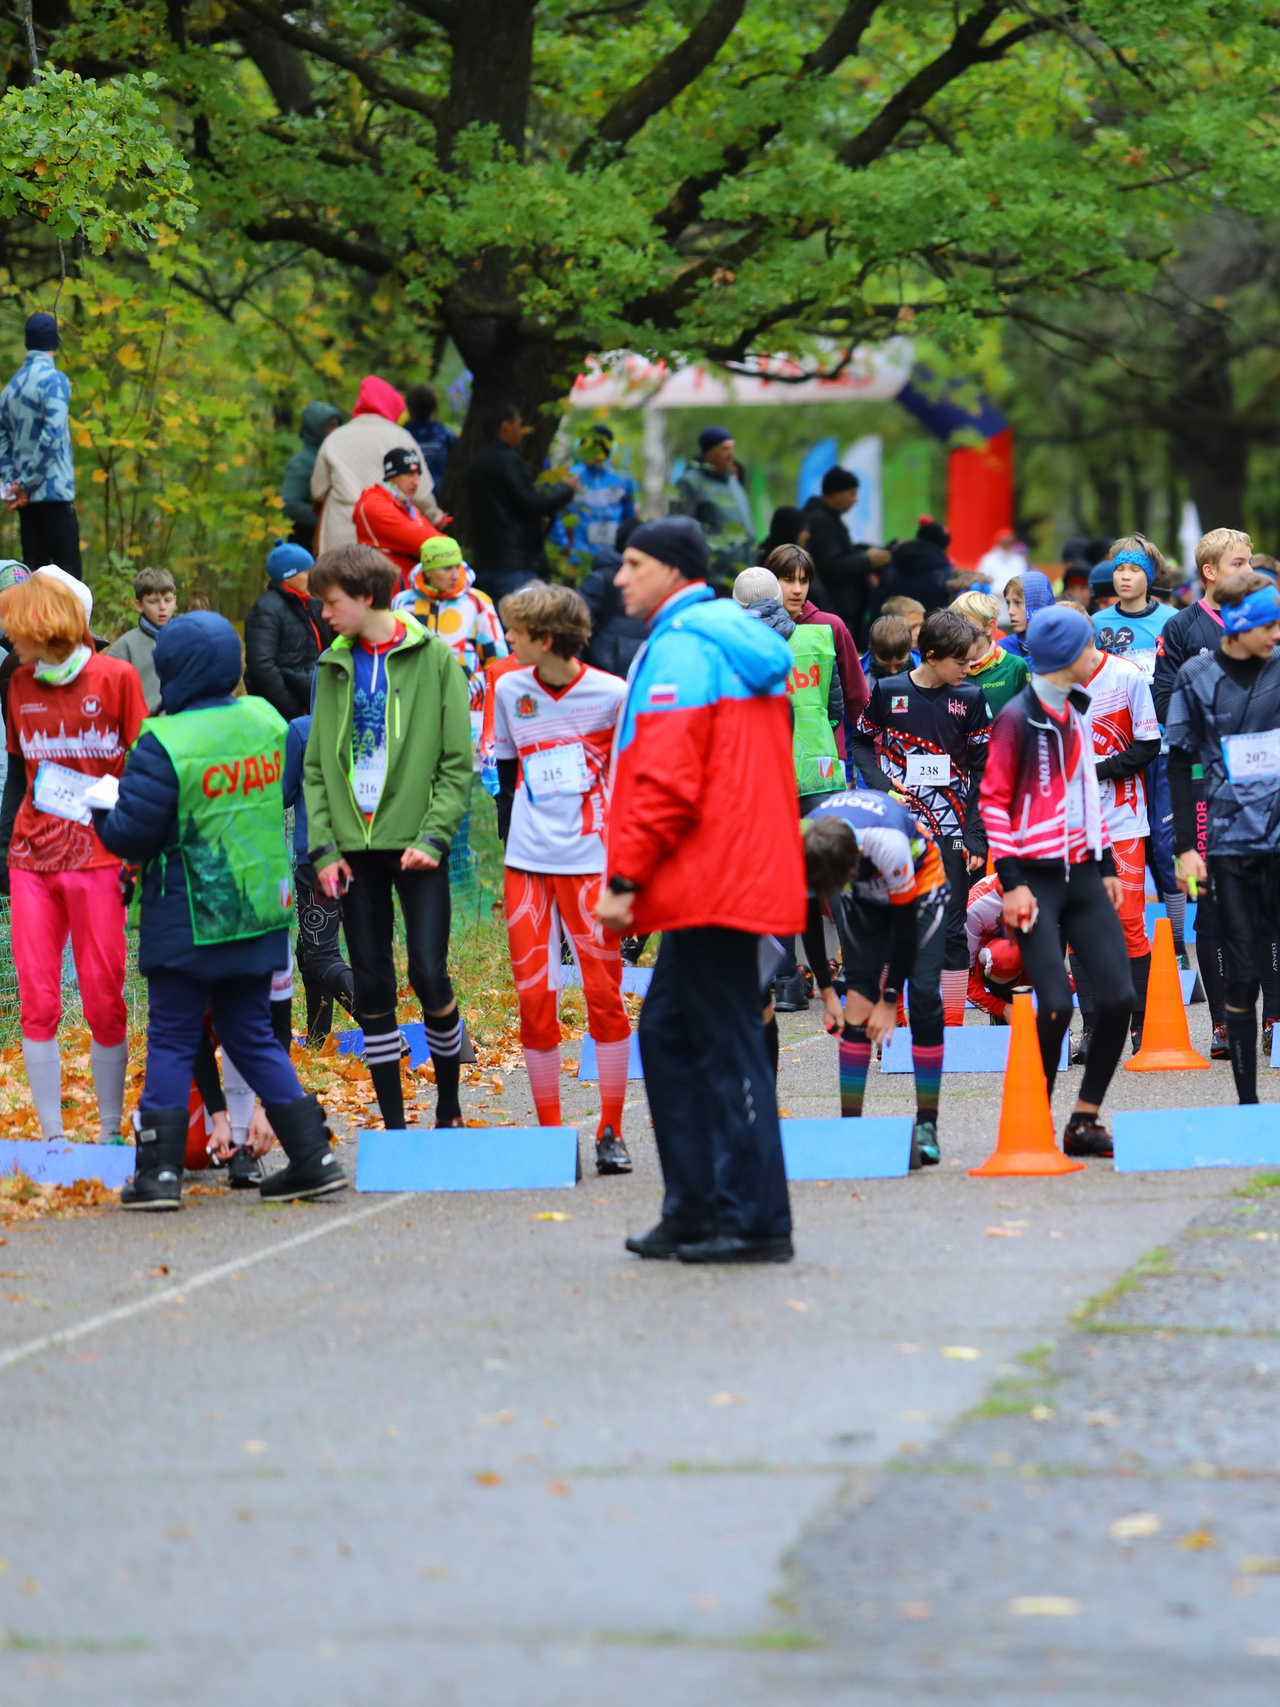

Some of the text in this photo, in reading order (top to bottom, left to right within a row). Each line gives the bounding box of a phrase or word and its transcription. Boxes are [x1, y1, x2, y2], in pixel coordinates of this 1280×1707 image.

[1245, 751, 1268, 764] 207
[202, 750, 281, 799] СУДЬЯ
[542, 767, 563, 782] 215
[919, 765, 939, 776] 238
[359, 782, 377, 794] 216
[1195, 801, 1208, 866] АРАТОВ
